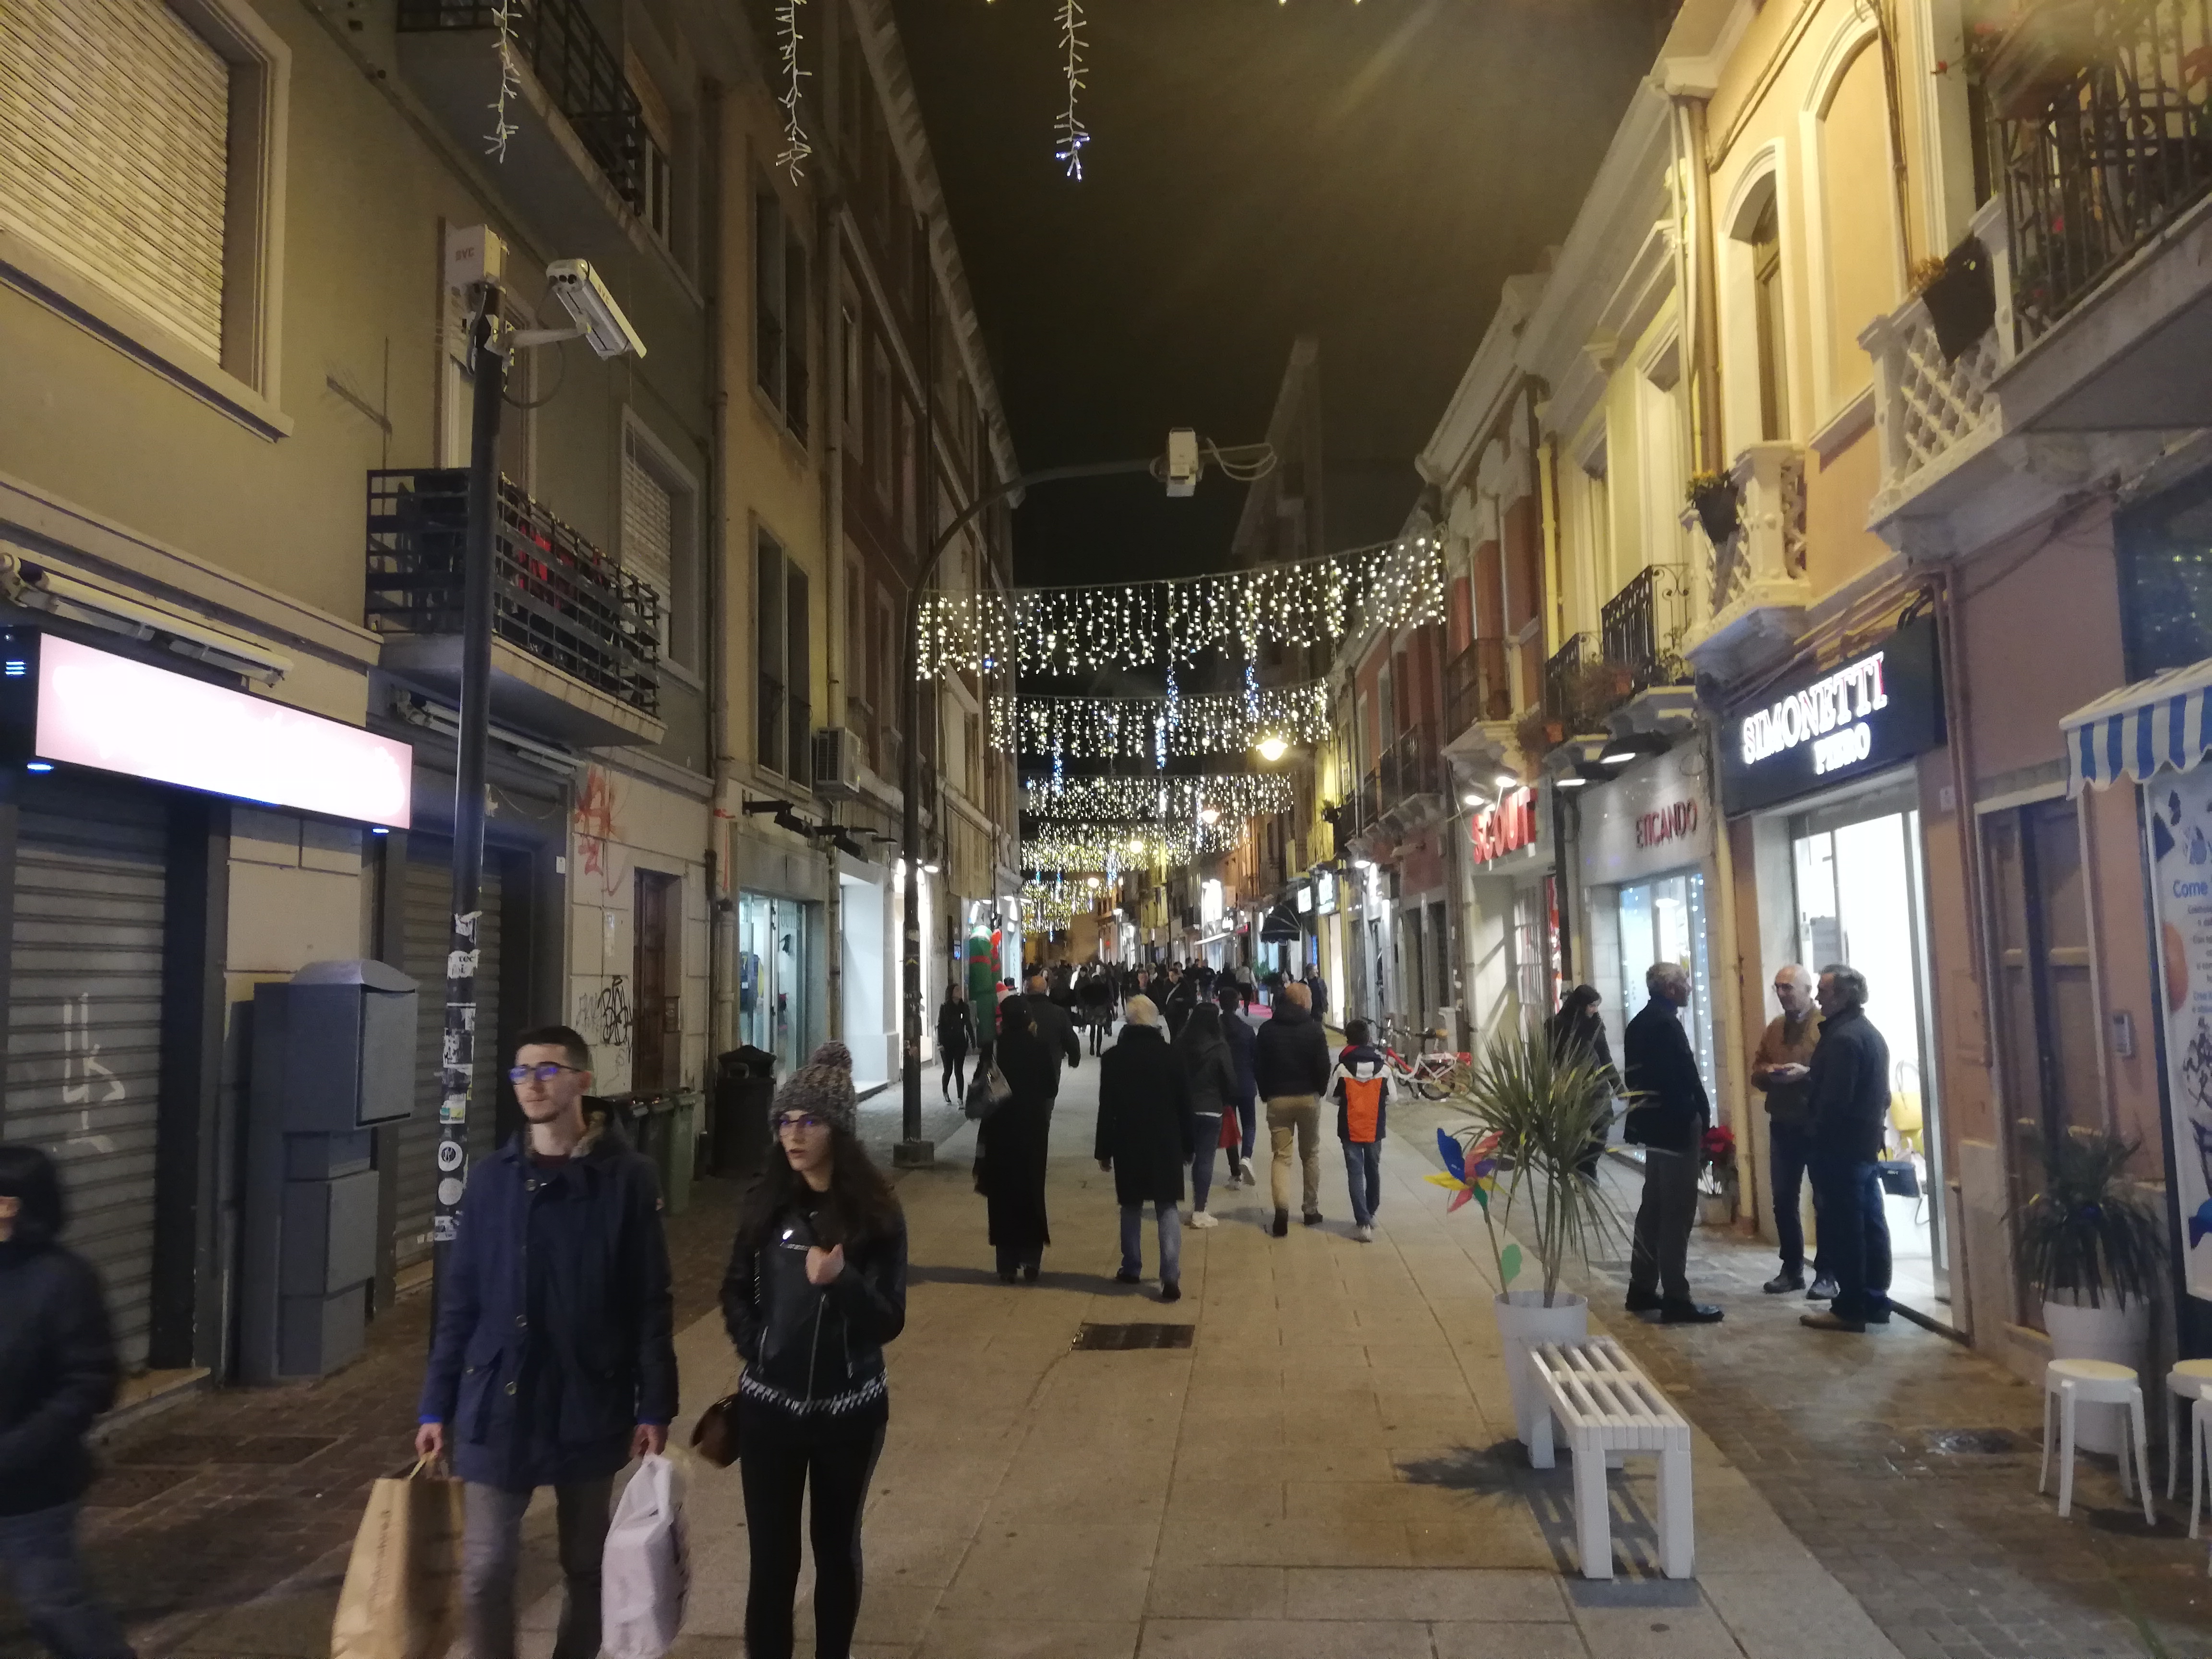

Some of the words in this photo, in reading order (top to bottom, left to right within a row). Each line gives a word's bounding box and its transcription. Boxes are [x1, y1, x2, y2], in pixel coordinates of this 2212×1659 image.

[1743, 650, 1887, 765] SIMONETTI
[1472, 786, 1536, 864] SCOUT
[1636, 798, 1698, 849] ETICANDO
[2173, 879, 2208, 898] Come
